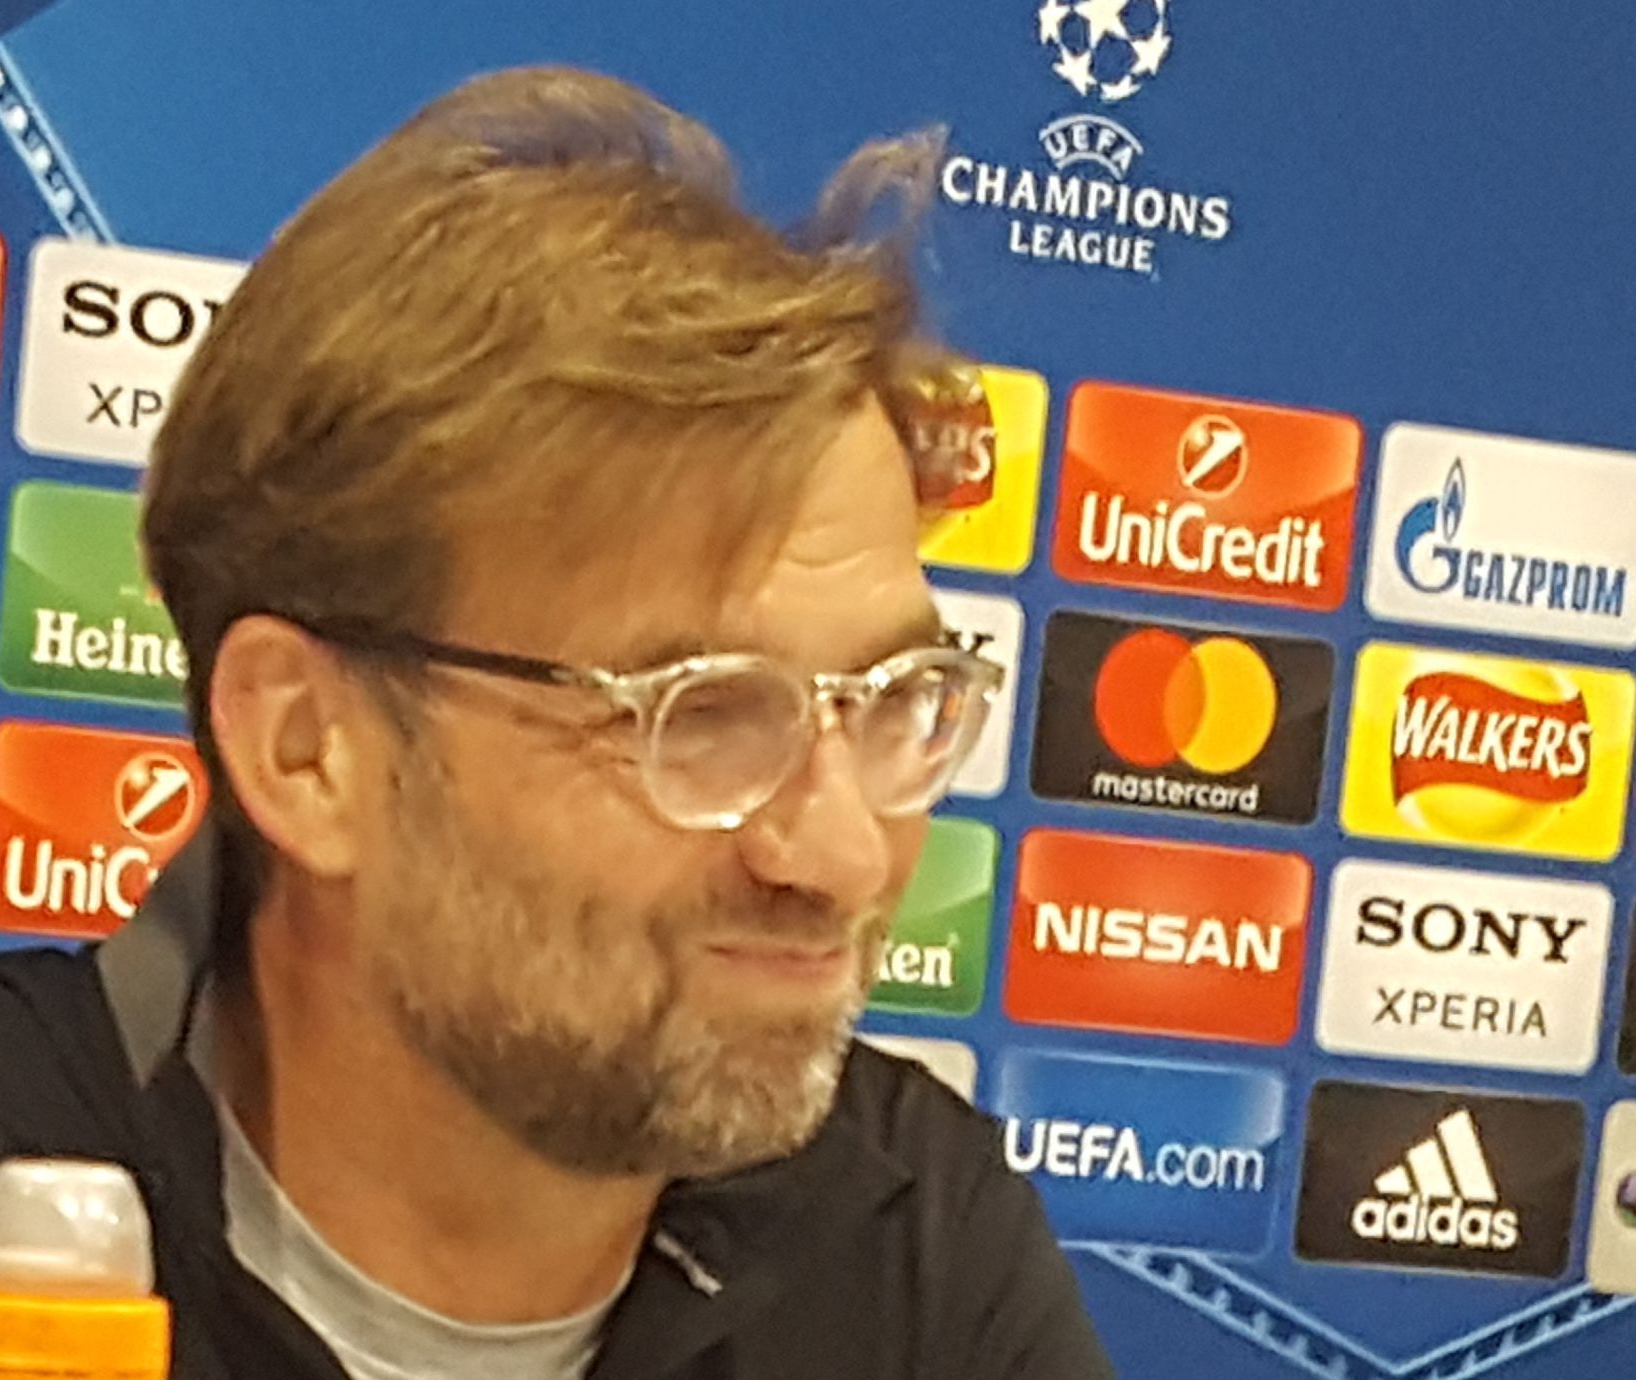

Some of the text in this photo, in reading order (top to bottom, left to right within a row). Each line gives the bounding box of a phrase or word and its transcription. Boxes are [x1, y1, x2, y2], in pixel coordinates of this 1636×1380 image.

[1044, 123, 1134, 176] UEFA
[942, 156, 1230, 239] CHAMPIONS
[1009, 220, 1155, 272] LEAGUE
[63, 280, 223, 348] SO
[1079, 491, 1324, 587] UniCredit
[1461, 554, 1627, 617] GAZPROM
[31, 608, 191, 680] Heine
[1394, 695, 1593, 779] WALKERS
[1093, 770, 1258, 814] mastercard
[1034, 902, 1282, 971] NISSAN
[1356, 897, 1587, 963] SONY
[1375, 987, 1549, 1038] XPERIA
[1005, 1117, 1264, 1192] UEFA.com
[1351, 1199, 1519, 1250] adidas
